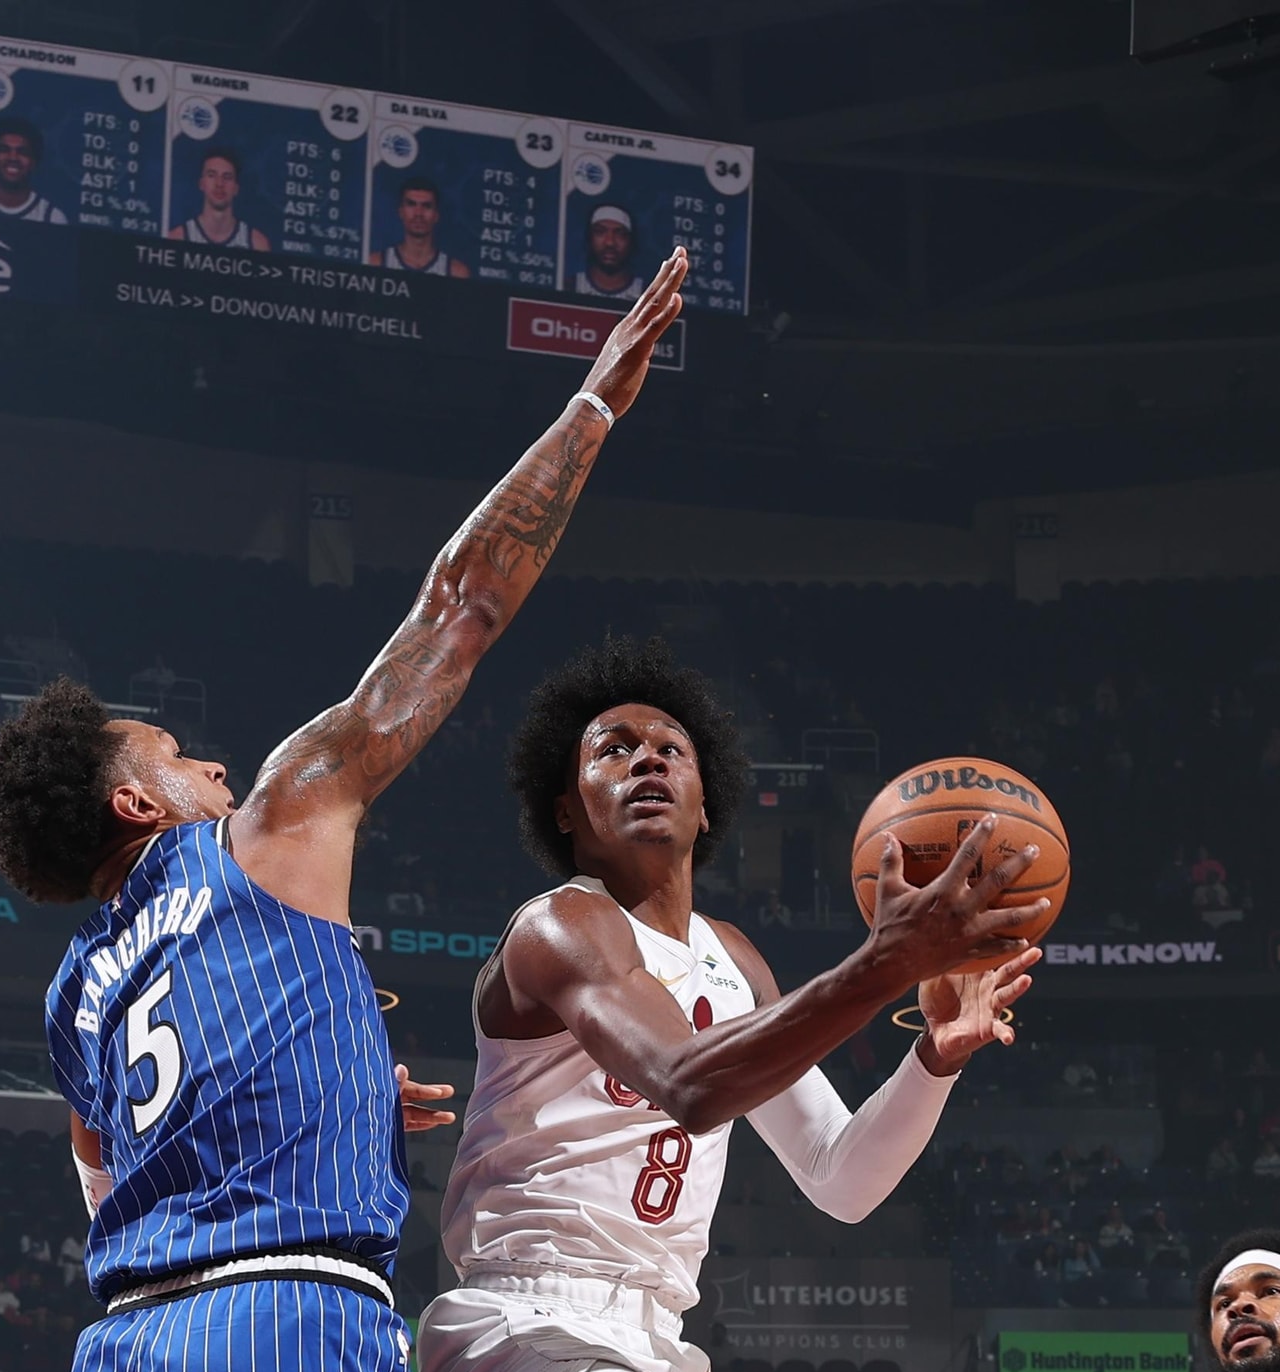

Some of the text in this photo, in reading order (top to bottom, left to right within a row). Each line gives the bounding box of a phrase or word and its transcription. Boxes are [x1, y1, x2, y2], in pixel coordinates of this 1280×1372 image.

[132, 75, 155, 94] 11
[191, 73, 250, 92] WAGNER
[330, 104, 359, 124] 22
[391, 102, 448, 121] DA SILVA
[129, 119, 140, 133] 0
[83, 133, 139, 154] TO: 0
[526, 133, 554, 151] 23
[584, 131, 657, 151] CARTER JR.
[82, 153, 138, 174] BLK: 0
[331, 148, 341, 161] 6
[286, 162, 341, 182] TO: 0
[715, 161, 742, 179] 34
[81, 172, 136, 193] AST: 1
[285, 181, 340, 201] BLK: 0
[526, 176, 536, 188] 4
[483, 189, 534, 209] TO: 1
[284, 200, 339, 220] AST: 0
[482, 208, 534, 228] BLK: 0
[715, 203, 725, 216] 0
[121, 217, 158, 232] 05:21
[673, 216, 724, 236] TO: 0
[481, 227, 532, 247] AST: 1
[324, 244, 359, 259] 05:21
[714, 242, 724, 254] 0
[136, 245, 177, 267] THE
[290, 266, 375, 294] TRISTAN
[381, 278, 411, 297] DA
[713, 260, 723, 272] 0
[519, 270, 553, 285] 05:21
[210, 295, 315, 325] DONOVAN
[321, 309, 422, 339] MITCHELL
[531, 317, 598, 343] Ohio
[777, 770, 808, 788] 216
[897, 766, 1042, 813] Wilson
[75, 886, 212, 1034] BANCHERO
[1101, 940, 1224, 965] KNOW.
[705, 972, 740, 991] CLIFFS
[124, 966, 183, 1138] 5
[631, 1126, 693, 1226] 8
[753, 1286, 908, 1306] LITEHOUSE
[727, 1334, 906, 1350] HAMPIONS CLUB
[1140, 1353, 1187, 1371] Bank
